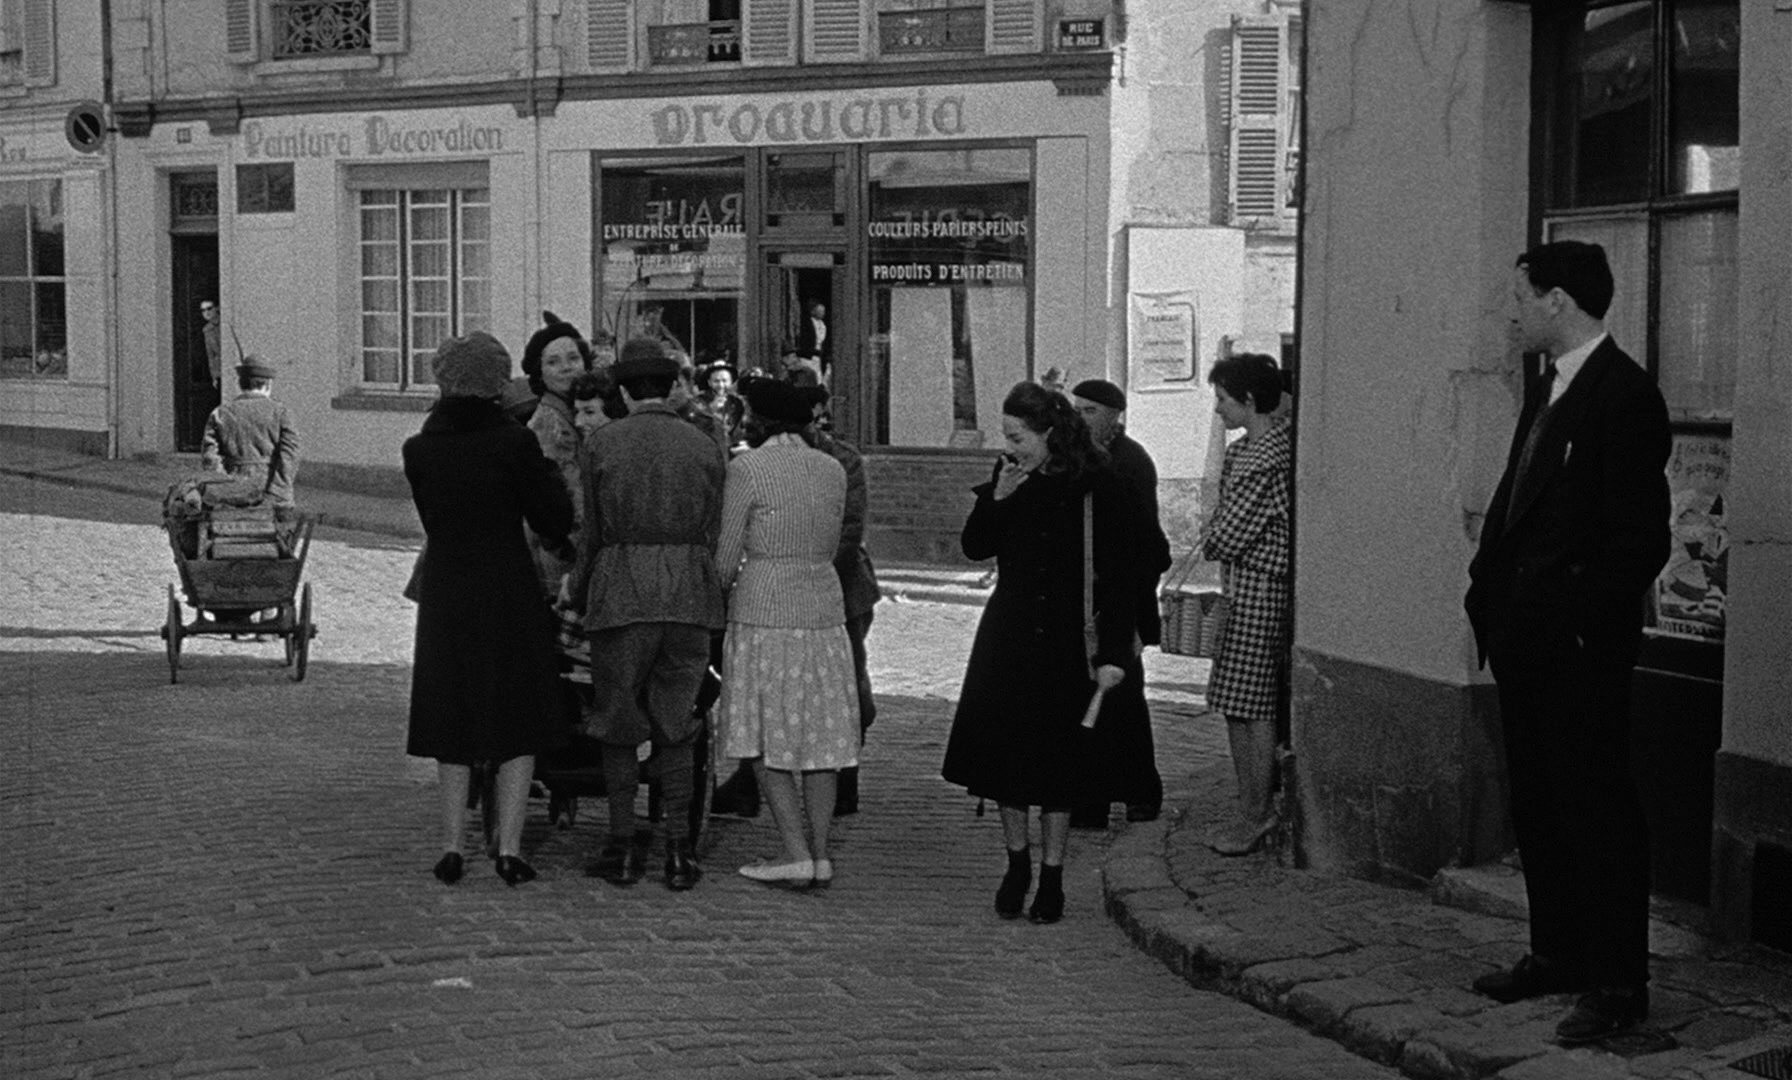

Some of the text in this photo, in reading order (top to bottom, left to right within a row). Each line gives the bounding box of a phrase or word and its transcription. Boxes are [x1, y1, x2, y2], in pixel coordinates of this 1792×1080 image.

[1069, 22, 1094, 33] RUE
[603, 223, 679, 239] ENTREPRISE
[939, 263, 1025, 280] D'ENTRETIEN
